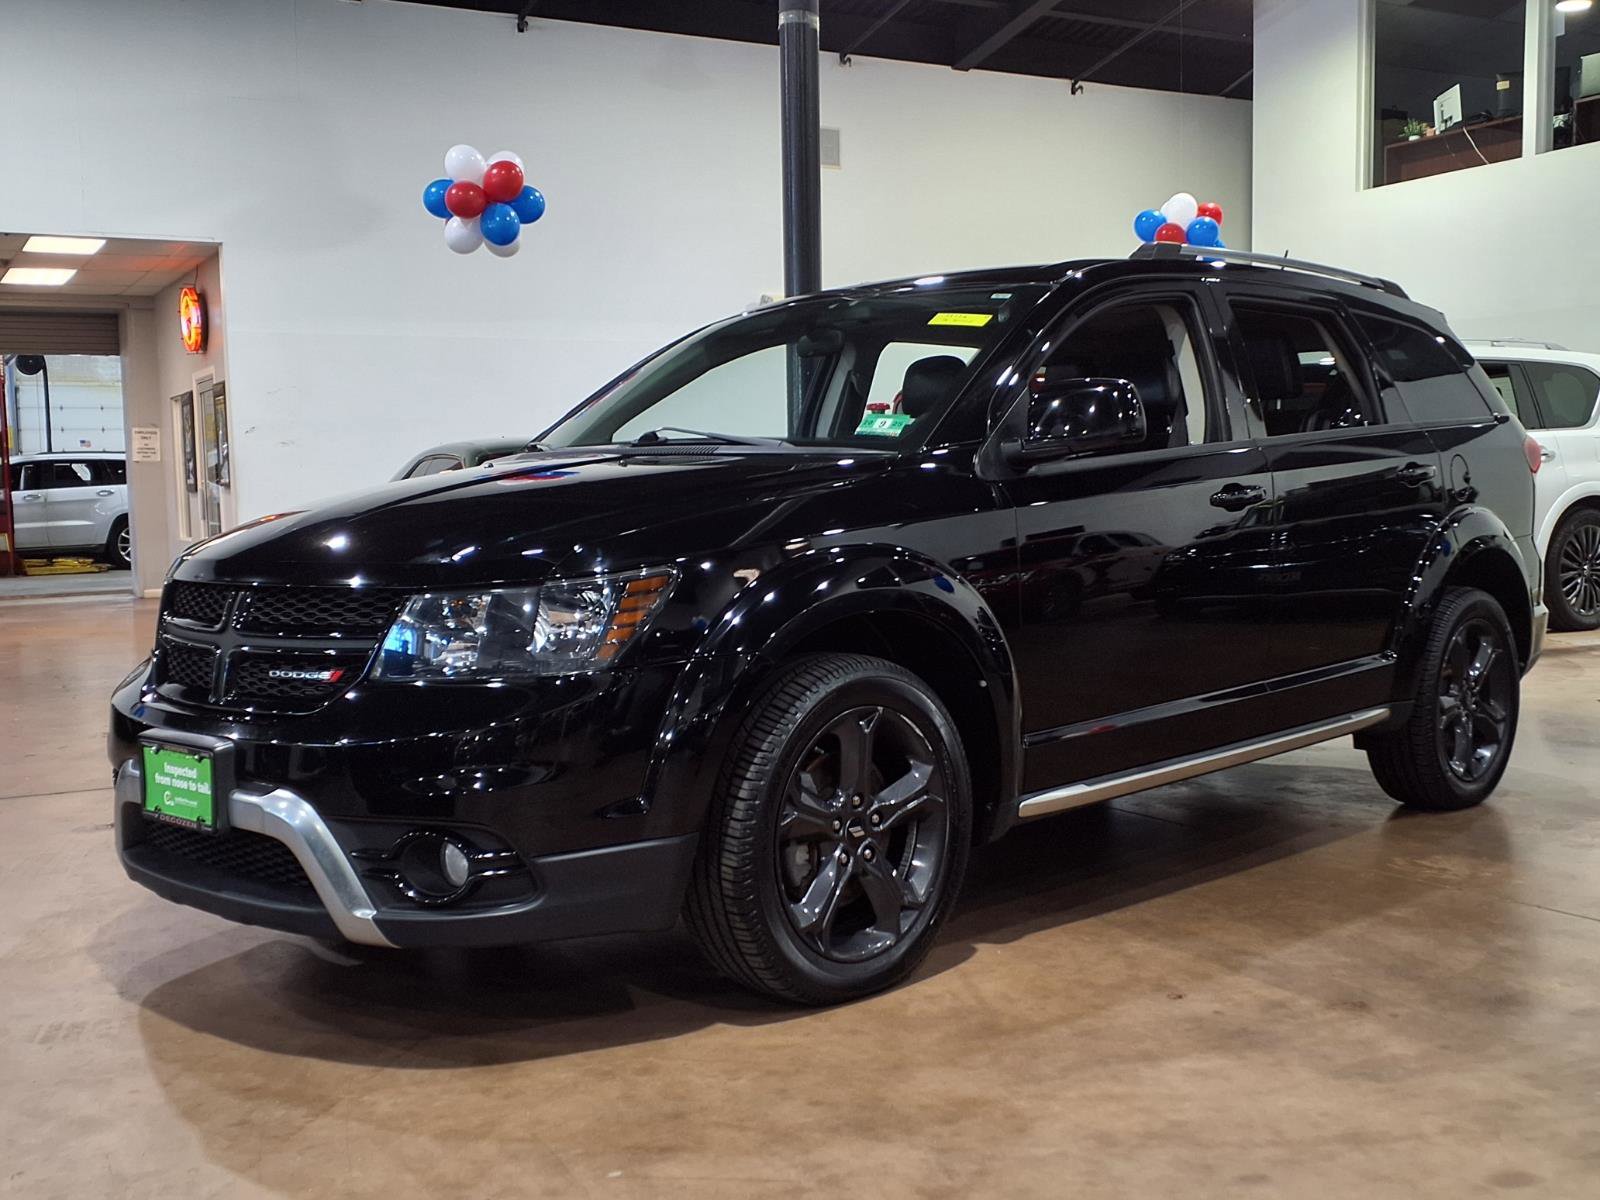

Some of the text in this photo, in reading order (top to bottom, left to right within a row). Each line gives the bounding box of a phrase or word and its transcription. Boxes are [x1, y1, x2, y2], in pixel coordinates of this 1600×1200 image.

[268, 670, 333, 680] DODGE
[164, 761, 198, 779] Inspected
[154, 772, 171, 787] from
[171, 777, 188, 790] nose
[188, 780, 197, 792] to
